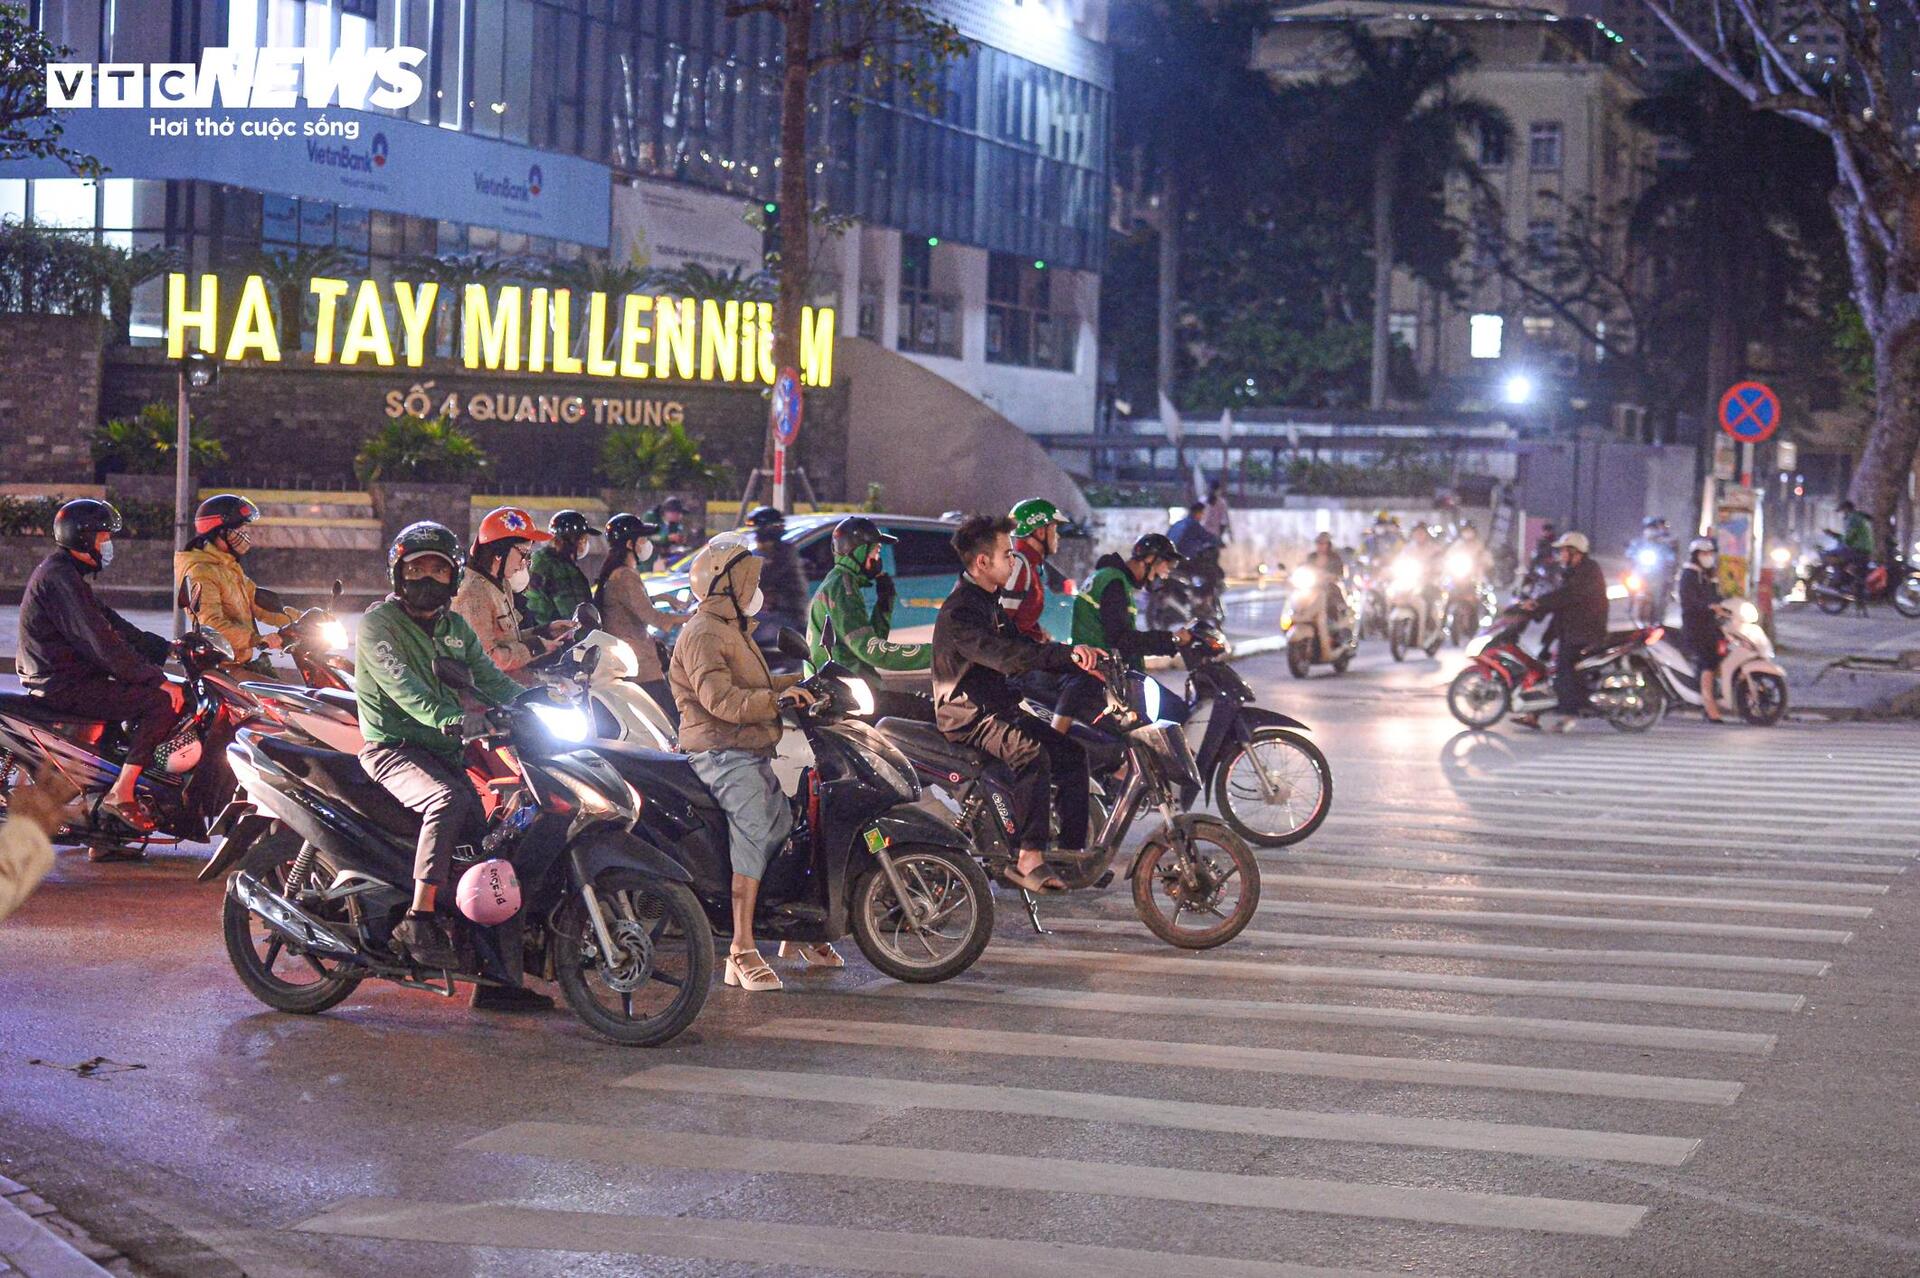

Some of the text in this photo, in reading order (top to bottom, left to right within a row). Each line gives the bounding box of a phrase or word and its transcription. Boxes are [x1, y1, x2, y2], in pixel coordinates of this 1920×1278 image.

[168, 273, 281, 362] HA
[310, 277, 439, 367] TAY
[468, 393, 587, 424] QUANG
[592, 397, 685, 427] TRUNG
